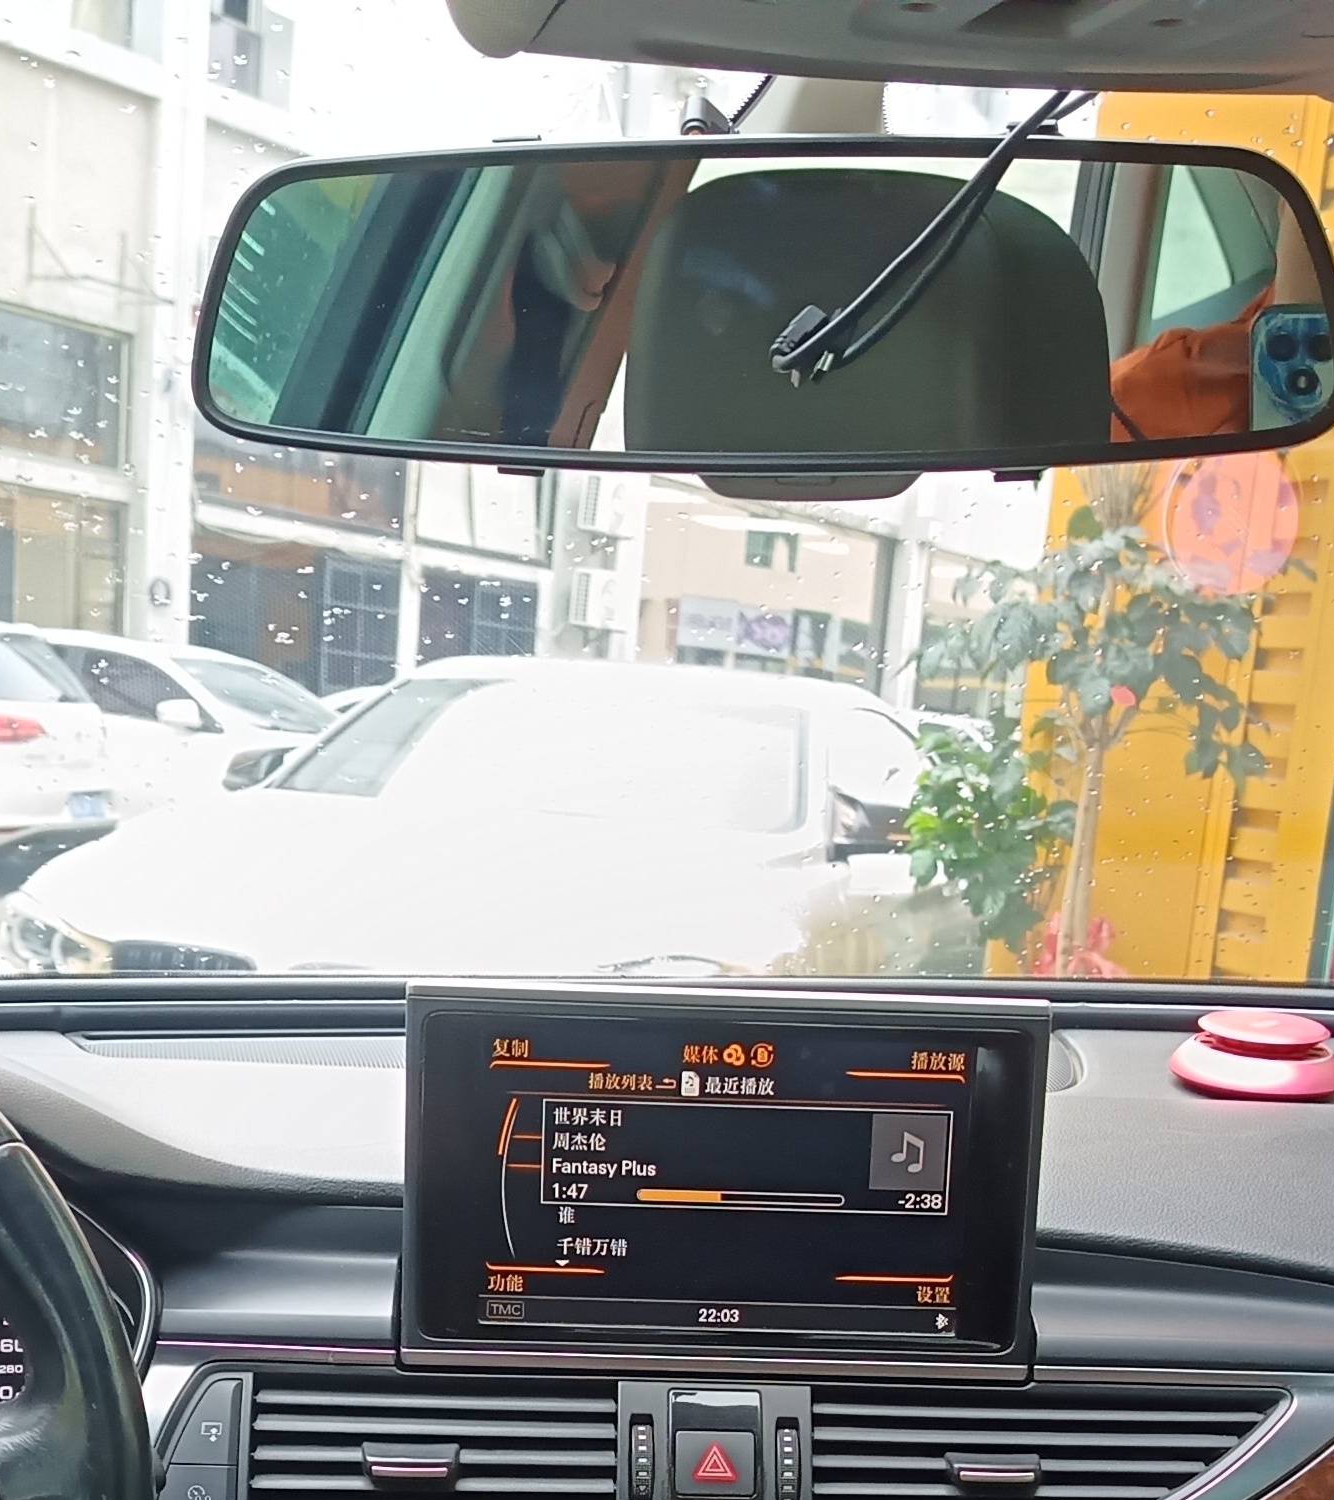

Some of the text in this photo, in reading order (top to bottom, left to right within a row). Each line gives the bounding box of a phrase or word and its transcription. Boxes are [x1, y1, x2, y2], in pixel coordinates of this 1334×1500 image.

[492, 1038, 529, 1058] 复制
[682, 1045, 718, 1064] 媒体
[911, 1051, 966, 1071] 播放源
[588, 1072, 653, 1091] 播放列表
[704, 1076, 775, 1096] 最近播放
[553, 1107, 623, 1127] 世界末日
[552, 1132, 607, 1151] 周杰伦
[552, 1157, 657, 1178] Fantasy Plus
[552, 1183, 588, 1199] 1:47
[898, 1193, 942, 1210] -2:38
[558, 1206, 575, 1224] 谁
[557, 1237, 628, 1257] 千错万错
[487, 1275, 523, 1293] 功能
[916, 1286, 951, 1304] 设置
[491, 1303, 521, 1316] TMC
[698, 1309, 739, 1323] 22:03
